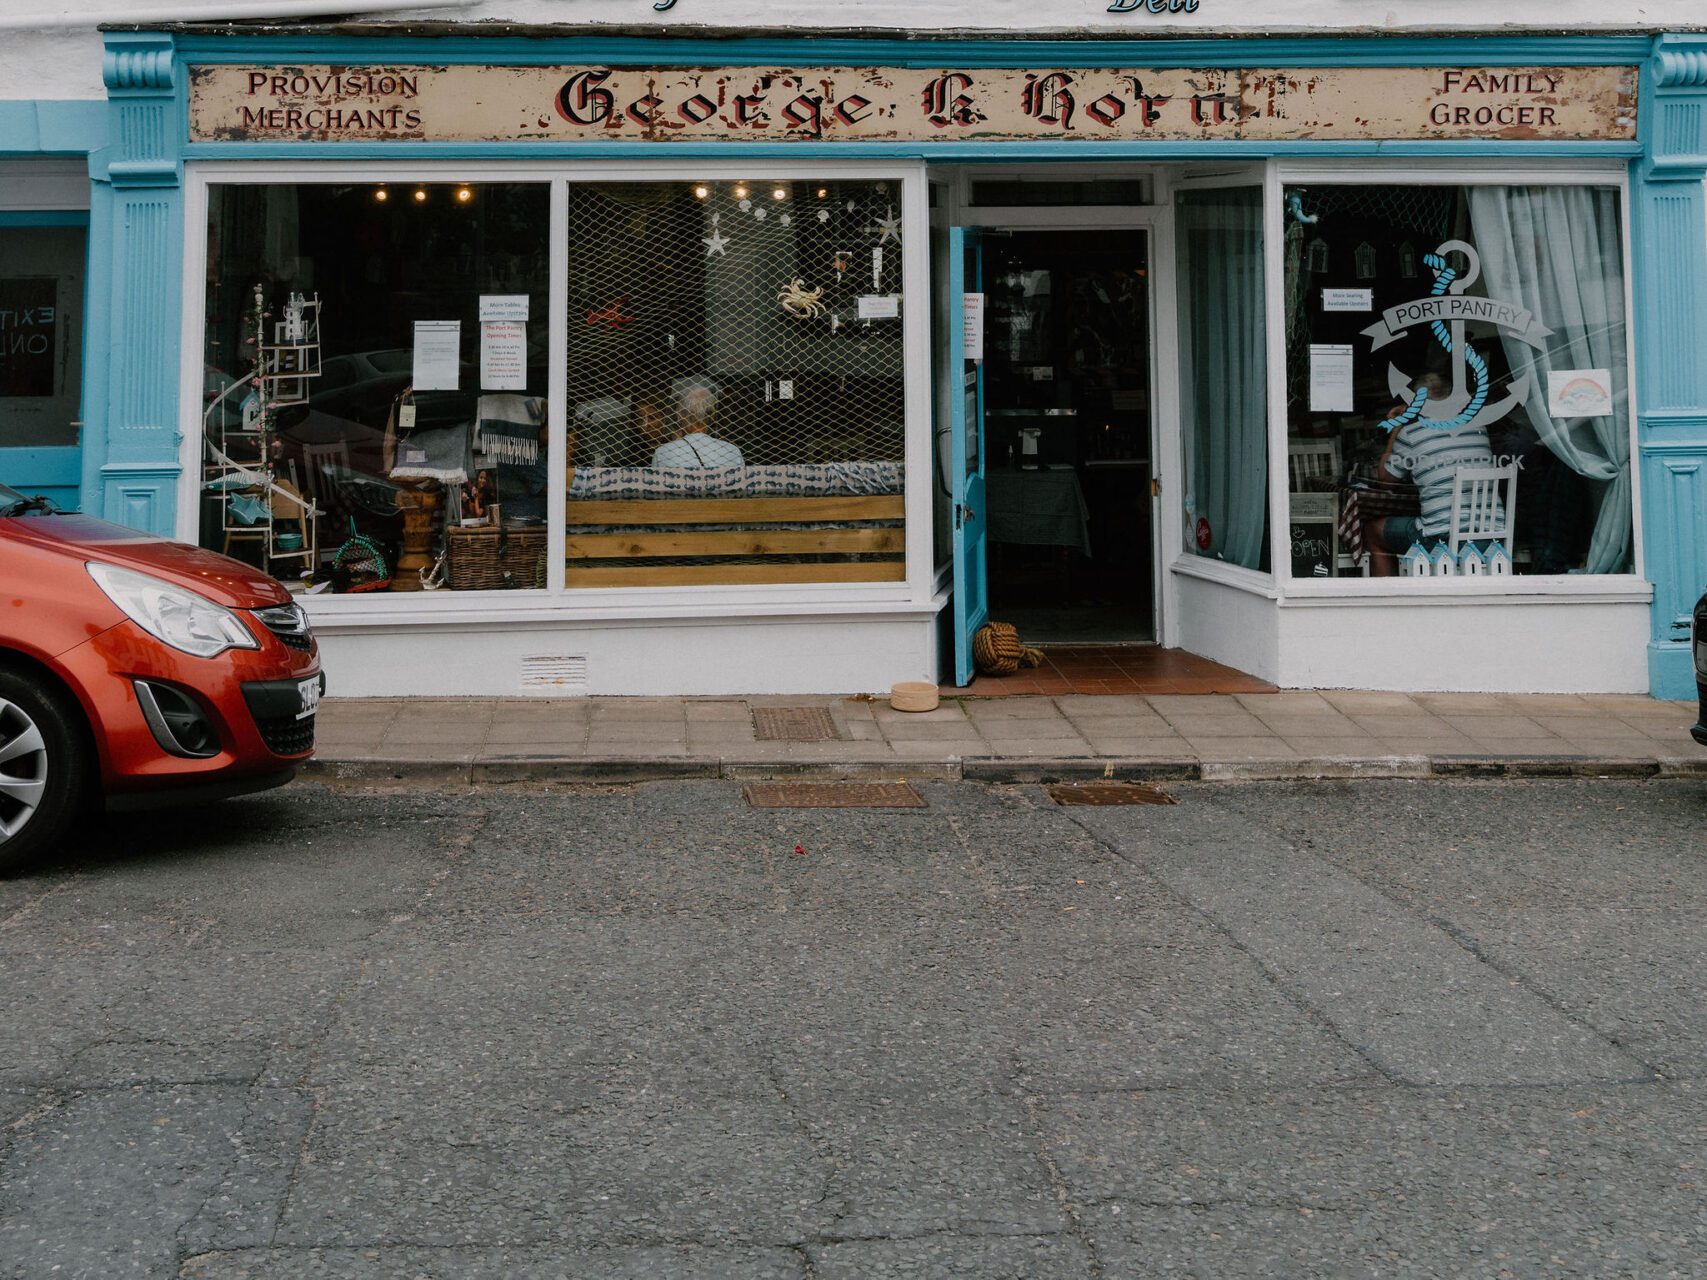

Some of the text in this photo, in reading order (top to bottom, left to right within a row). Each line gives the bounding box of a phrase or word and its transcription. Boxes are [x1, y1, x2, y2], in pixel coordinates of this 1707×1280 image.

[248, 72, 420, 97] PROVISION
[1442, 71, 1564, 94] FAMILY
[554, 69, 876, 134] George
[242, 106, 422, 130] MERCHANTS
[1429, 102, 1558, 127] GROCER
[1395, 300, 1522, 324] PORT PANTRY
[1390, 454, 1525, 471] PORPATRICK
